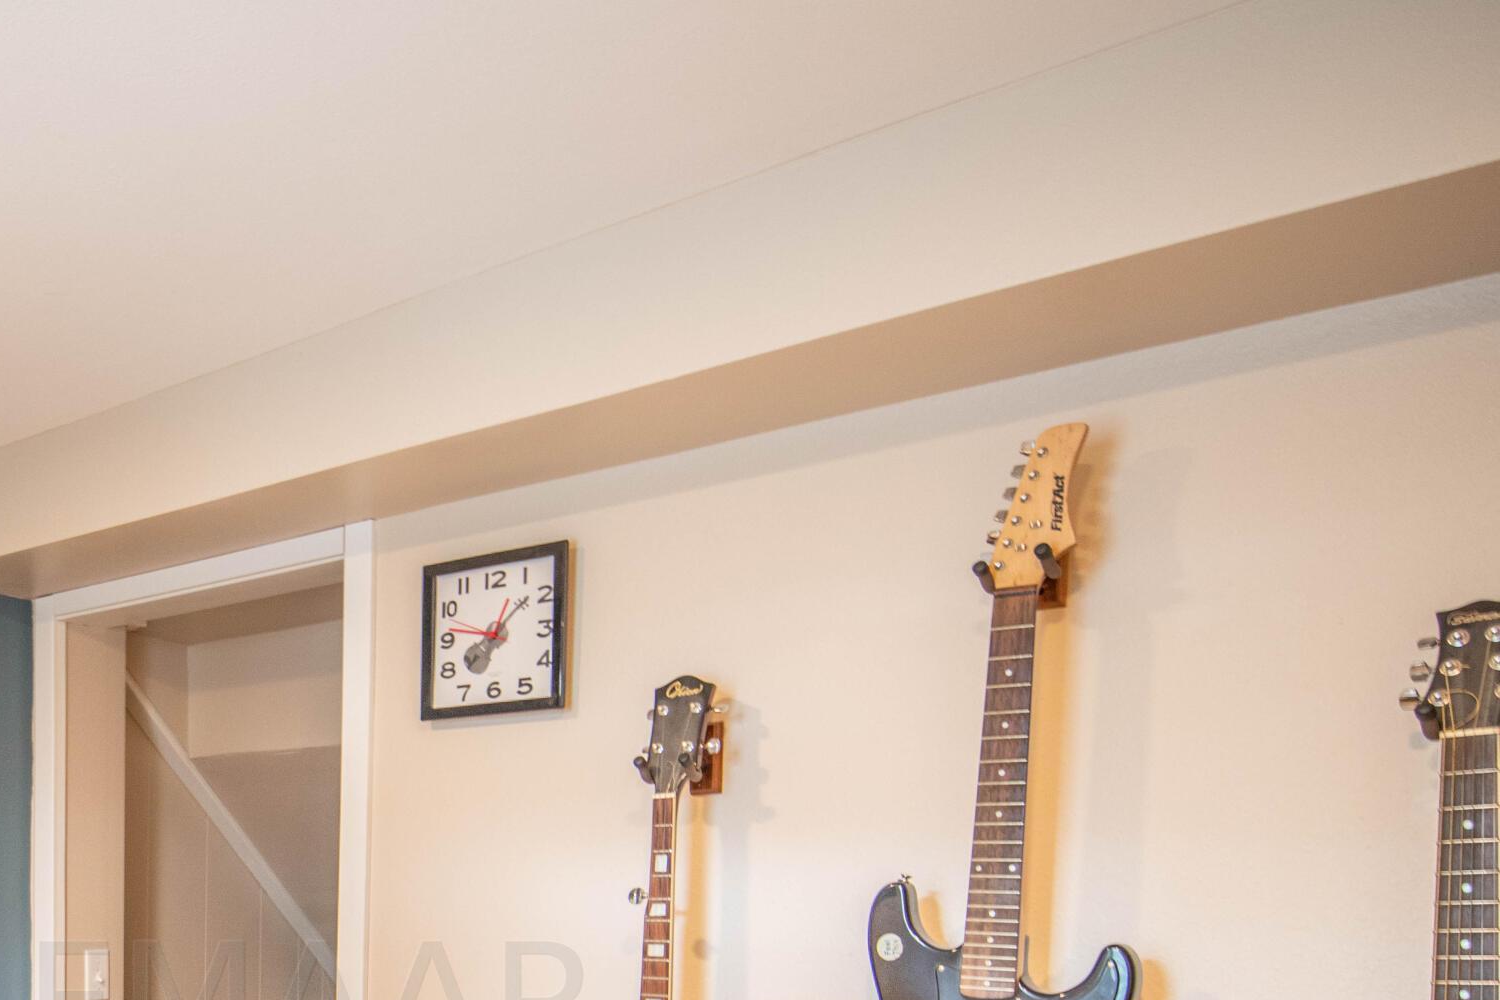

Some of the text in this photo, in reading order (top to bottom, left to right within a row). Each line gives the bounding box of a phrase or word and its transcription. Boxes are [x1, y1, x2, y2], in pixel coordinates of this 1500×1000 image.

[485, 571, 507, 590] 12
[523, 567, 528, 585] 1
[458, 576, 470, 595] 11
[537, 585, 553, 604] 2
[442, 601, 457, 618] 10
[537, 619, 553, 638] 3
[440, 632, 455, 649] 9
[536, 650, 553, 668] 4
[440, 662, 456, 679] 8
[457, 684, 471, 702] 7
[487, 681, 501, 698] 6
[517, 677, 533, 695] 5
